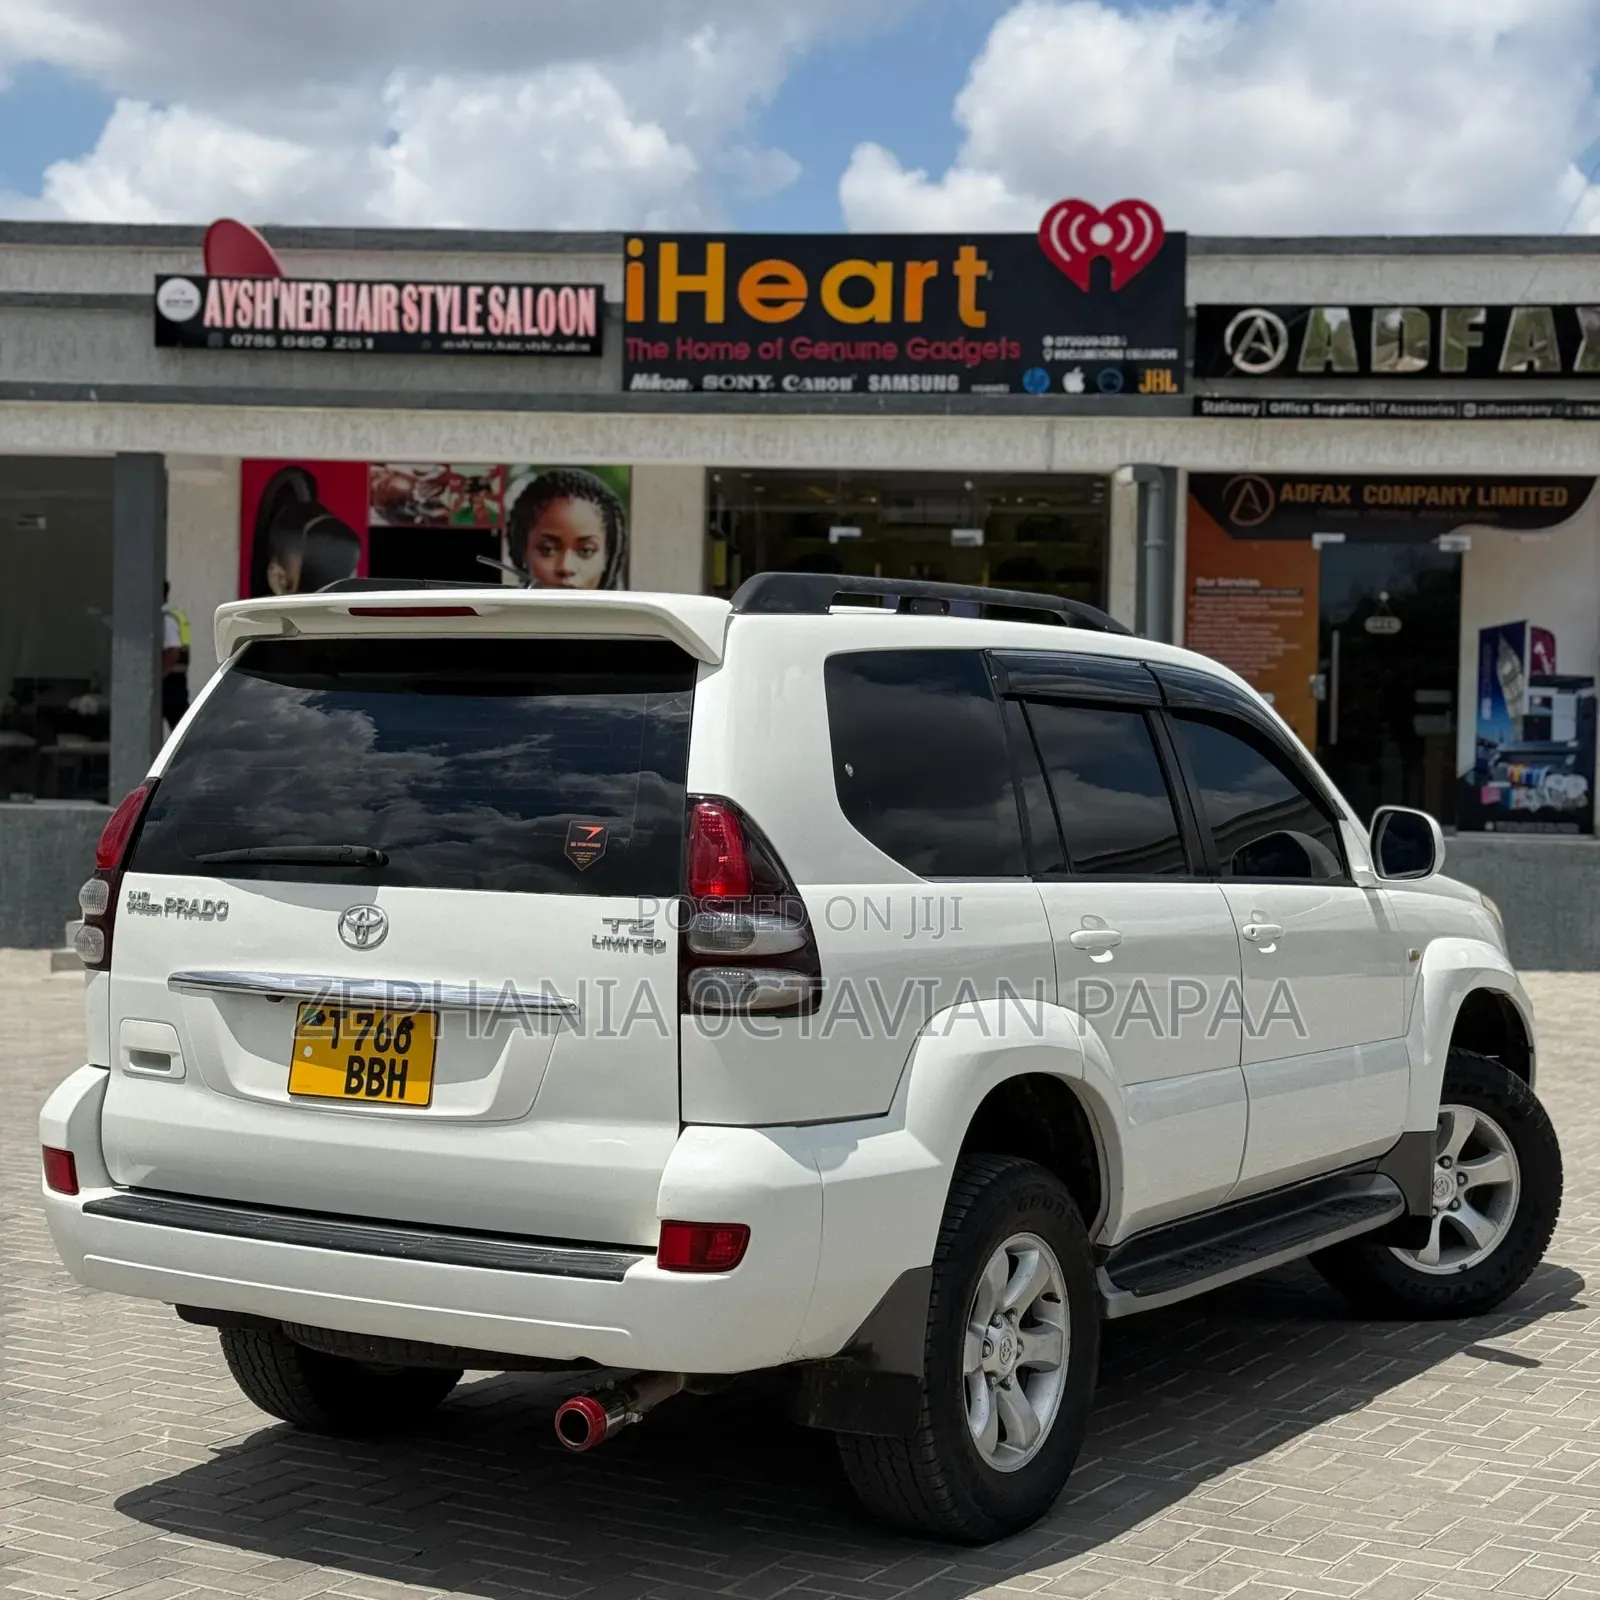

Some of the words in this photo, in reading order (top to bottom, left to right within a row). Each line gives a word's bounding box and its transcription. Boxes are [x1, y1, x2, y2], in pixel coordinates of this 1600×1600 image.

[625, 238, 989, 328] iHeart
[203, 277, 331, 331] AYSH'NER
[336, 282, 399, 333] HAIR
[401, 284, 484, 334] STYLE
[487, 286, 596, 337] SALOON
[626, 337, 670, 361] The
[676, 336, 751, 361] Home
[758, 336, 783, 361] of
[790, 336, 898, 362] Genuine
[906, 336, 1021, 367] Gadgets
[630, 372, 690, 391] Nikon
[702, 374, 773, 391] SONY
[782, 375, 853, 391] Canon
[868, 374, 960, 391] SAMSUNG
[1138, 368, 1178, 393] JBL
[1202, 400, 1260, 416] Stationery
[1268, 402, 1311, 415] Office
[1312, 402, 1370, 417] Supplies
[1388, 403, 1456, 416] Accessories
[1280, 482, 1351, 504] ADFAX
[1363, 484, 1472, 506] COMPANY
[1477, 486, 1568, 508] LIMITED
[164, 897, 230, 919] PRADO
[592, 934, 667, 953] LIMITED
[329, 1010, 348, 1050] T
[344, 1055, 409, 1099] BBH
